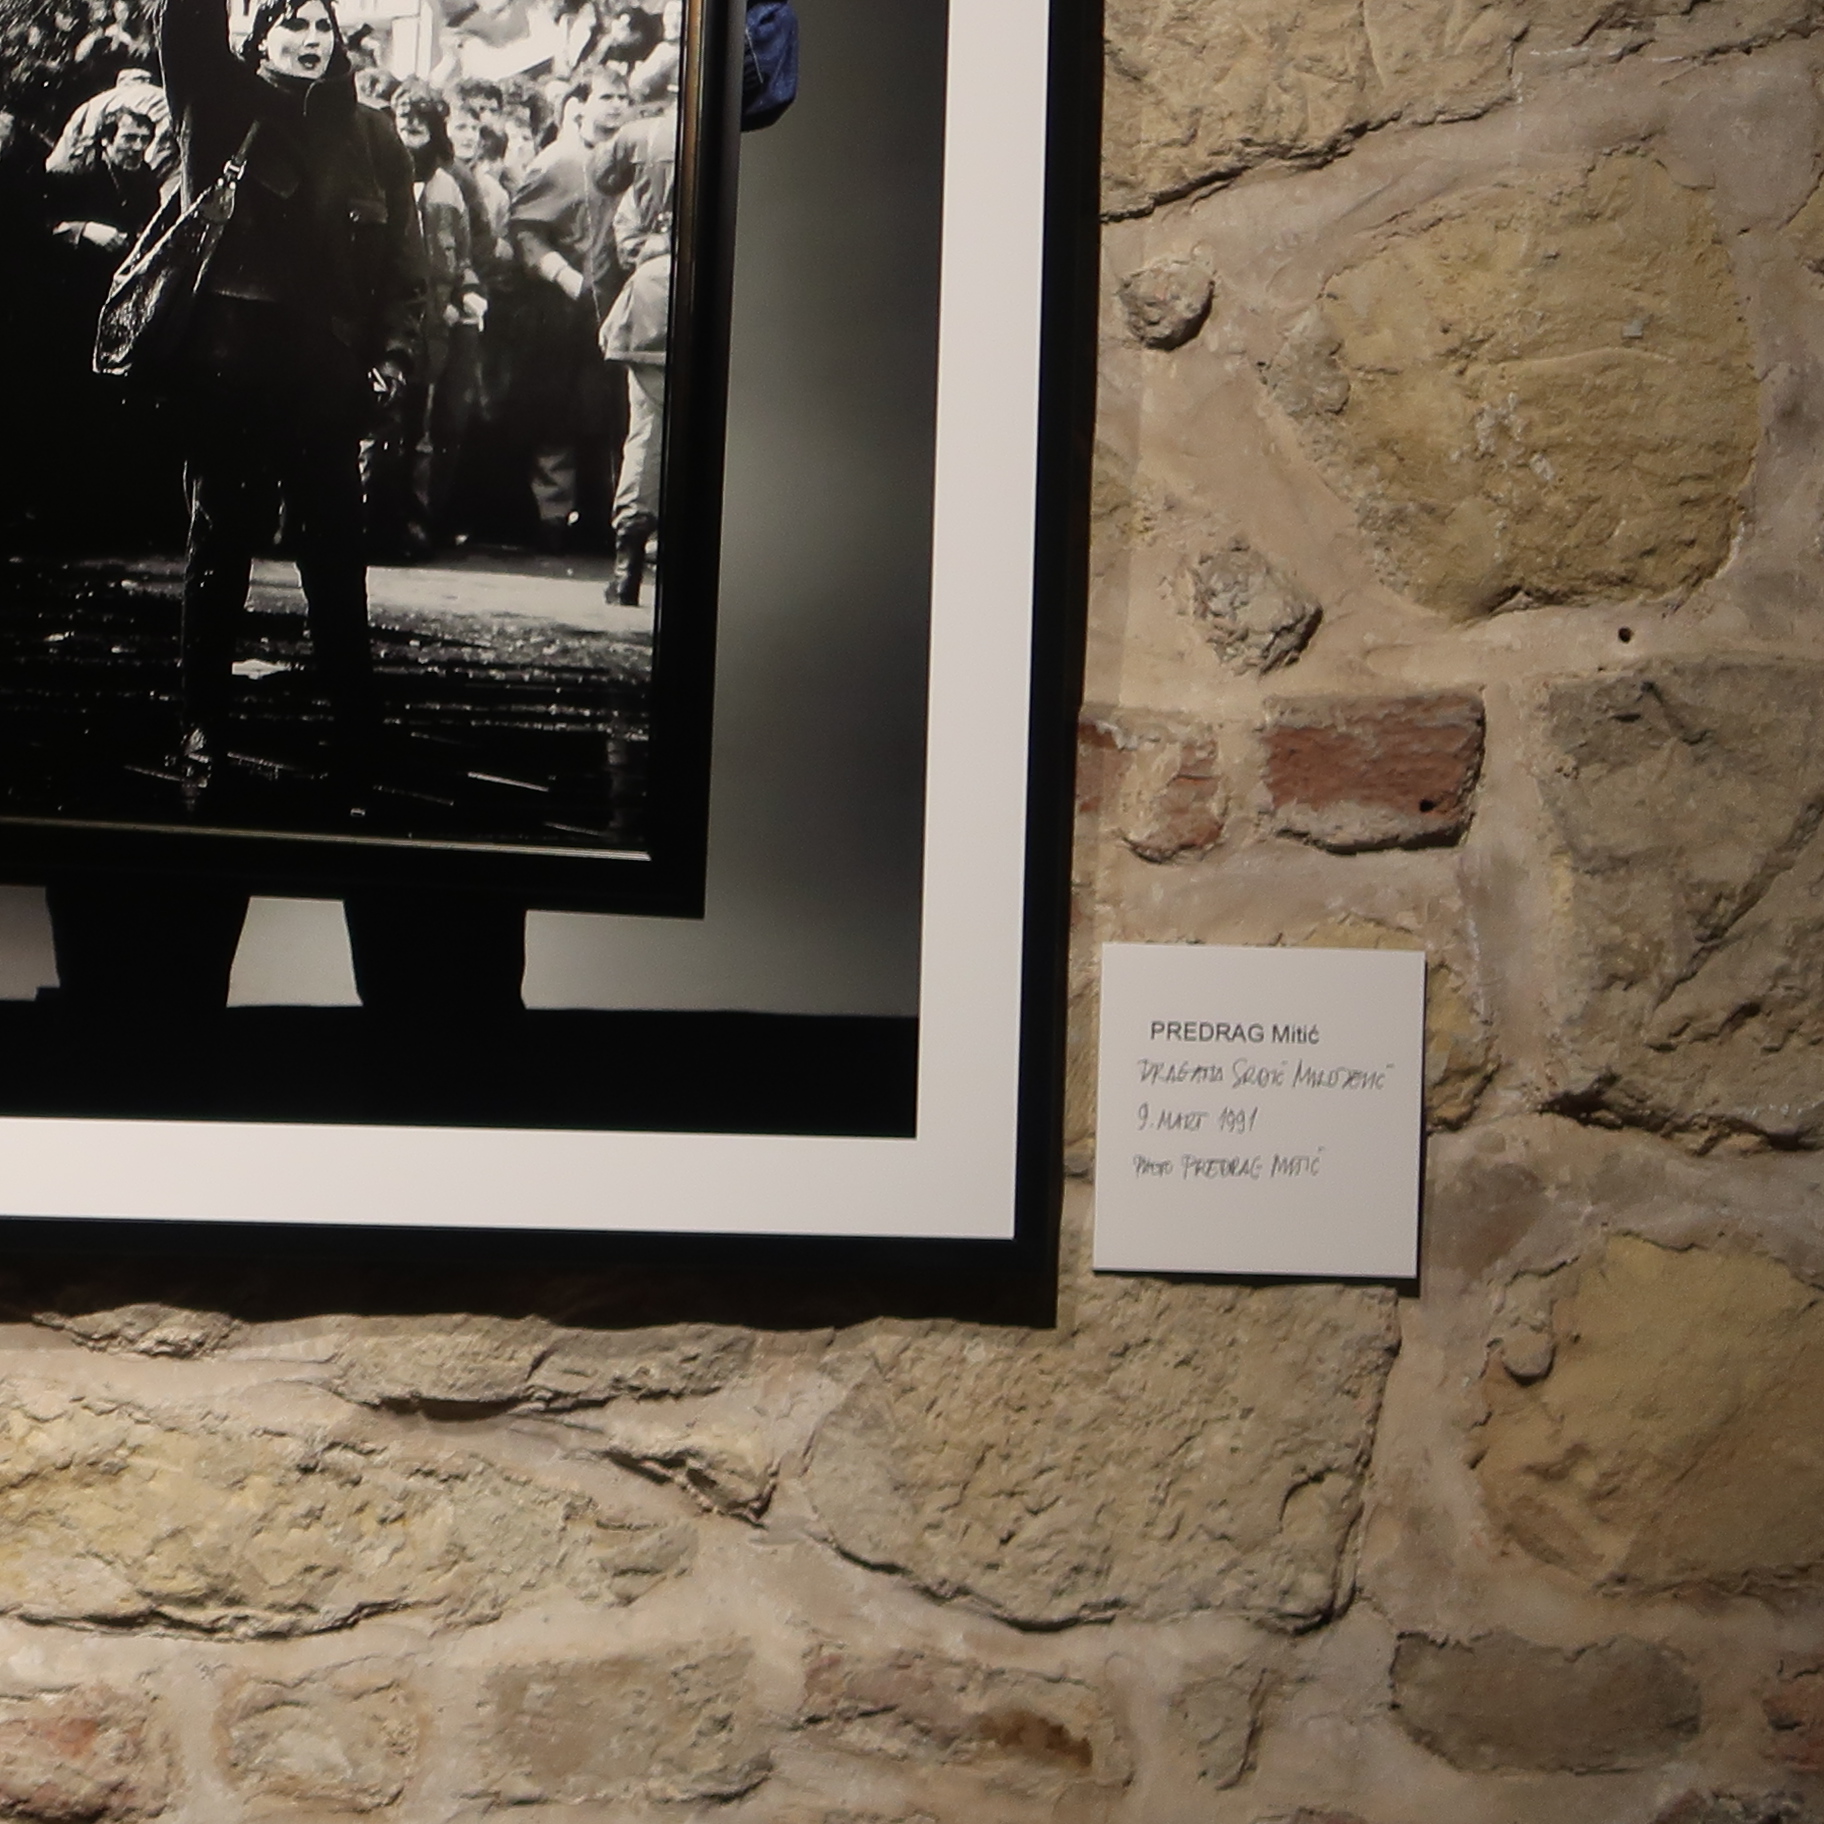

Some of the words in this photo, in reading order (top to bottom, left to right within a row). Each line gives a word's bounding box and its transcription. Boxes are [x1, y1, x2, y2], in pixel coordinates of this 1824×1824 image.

[1150, 1020, 1264, 1043] PREDRAG
[1272, 1023, 1319, 1045] Mitić
[1217, 1105, 1258, 1135] 1991
